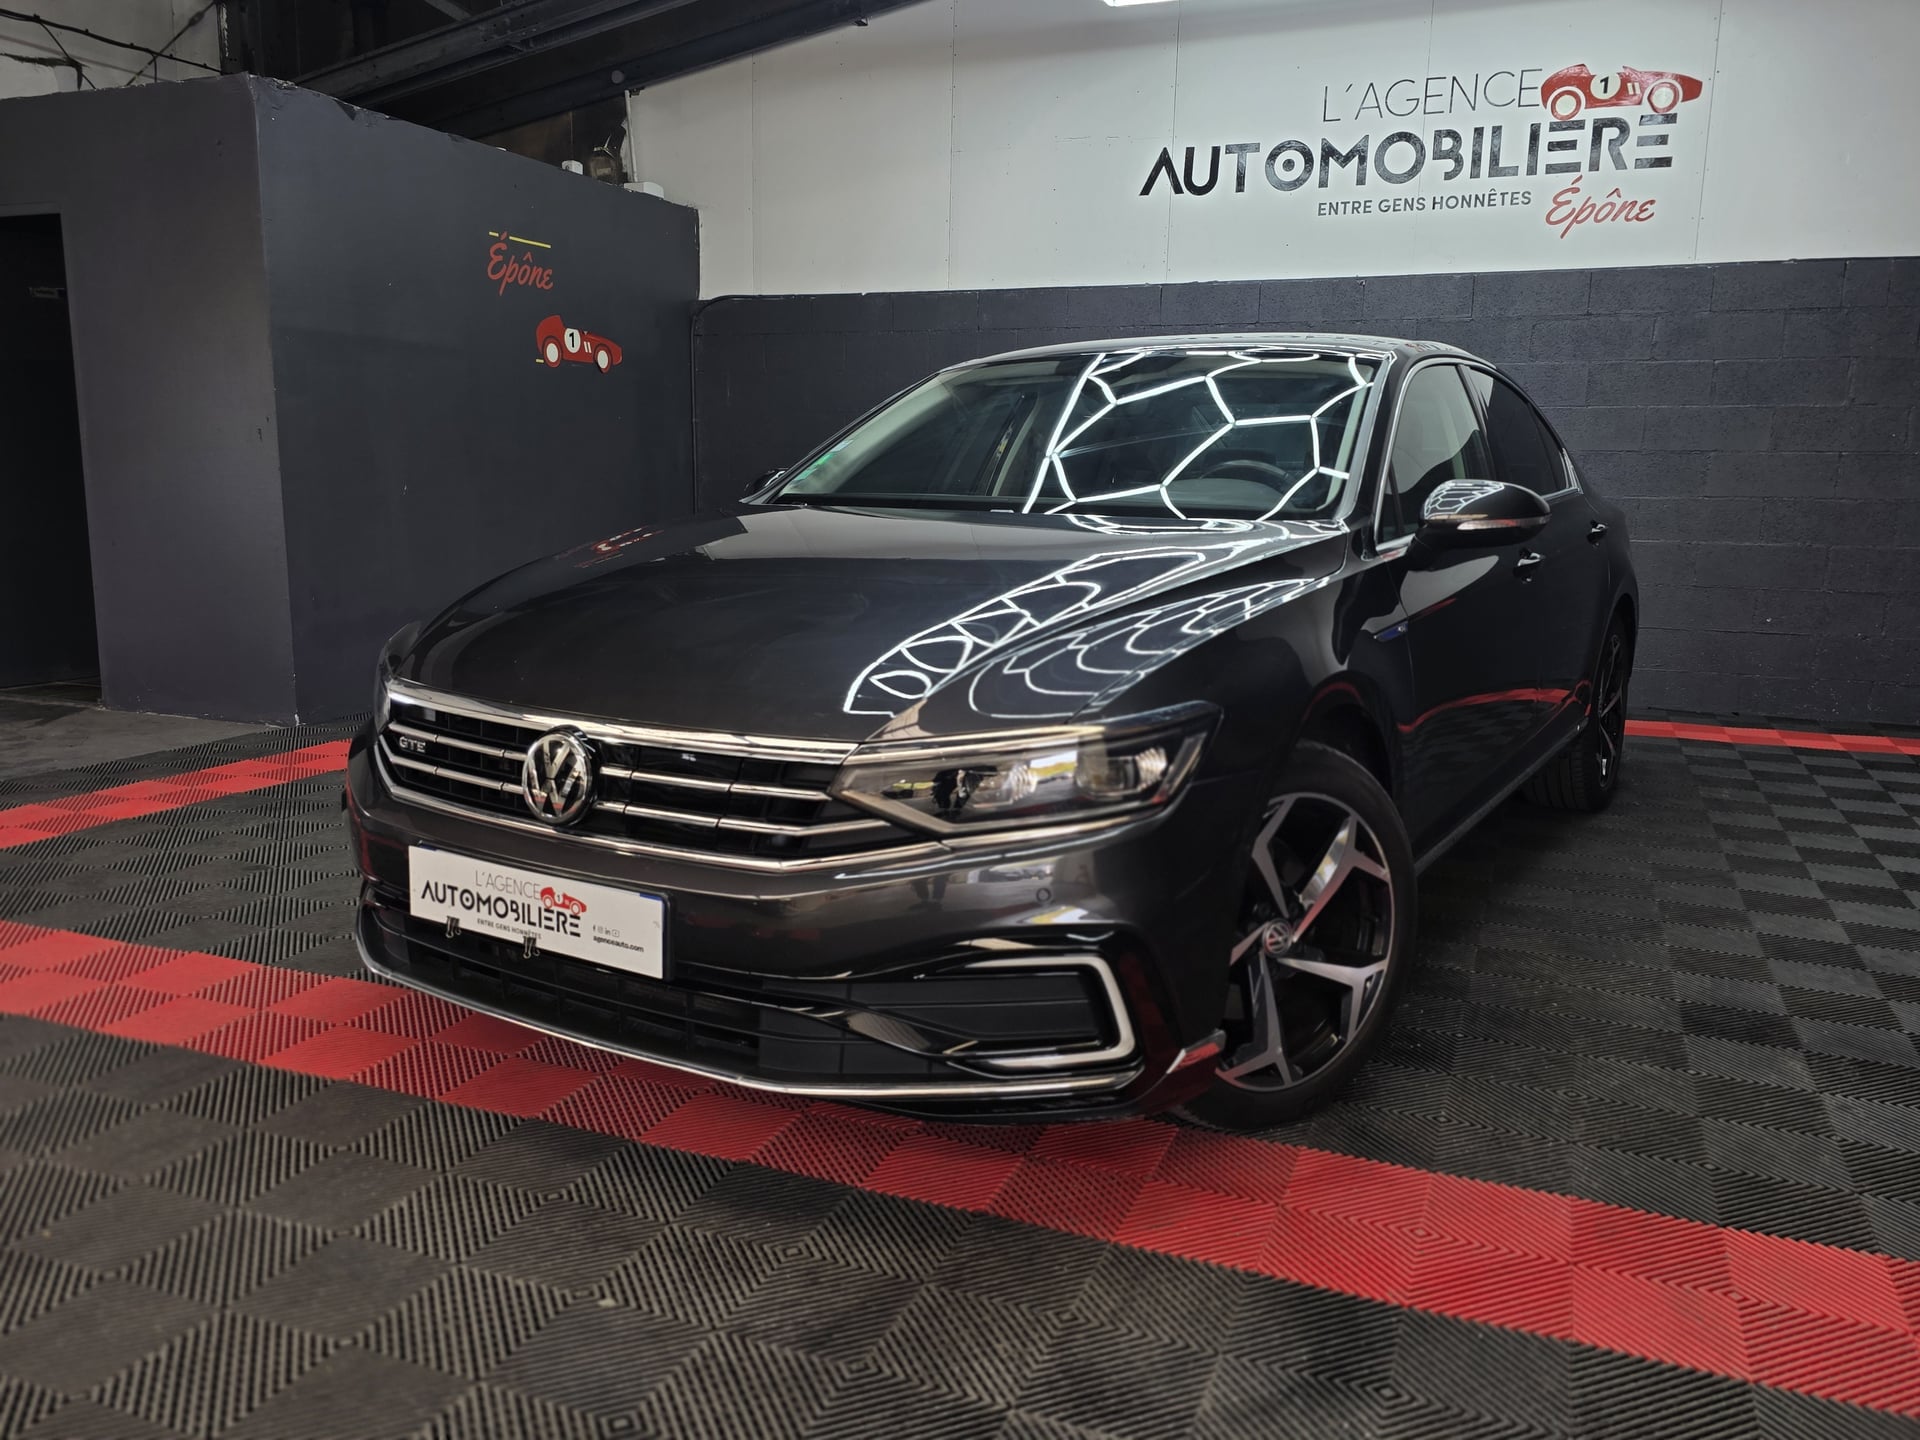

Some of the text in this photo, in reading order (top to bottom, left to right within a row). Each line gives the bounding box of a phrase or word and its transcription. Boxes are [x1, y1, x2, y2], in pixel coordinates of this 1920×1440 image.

[1317, 189, 1533, 217] ENTRE GENS HONNÊTES
[1544, 174, 1657, 240] Épône
[487, 231, 554, 297] Épône
[399, 735, 427, 753] GTE
[477, 918, 494, 928] ENTRE
[495, 923, 511, 932] GENS
